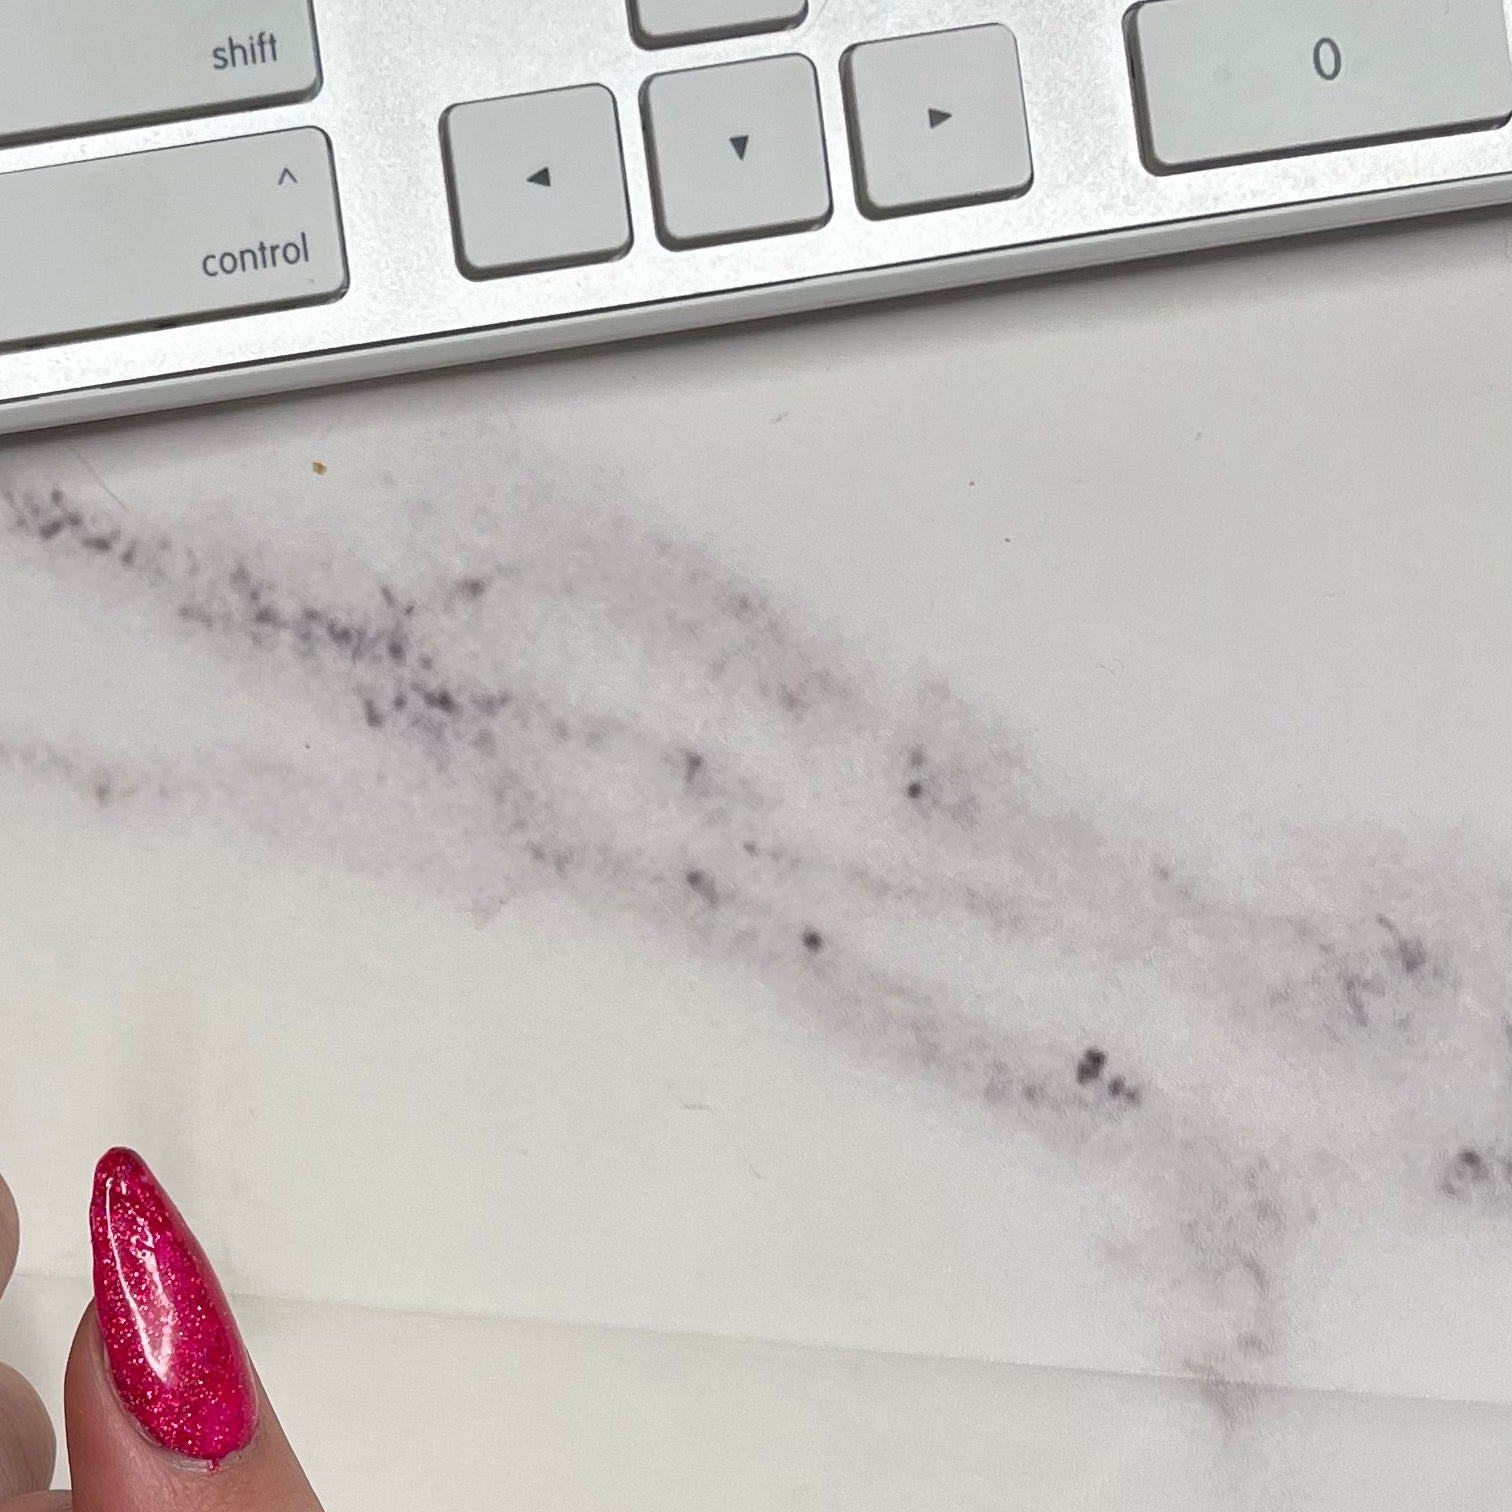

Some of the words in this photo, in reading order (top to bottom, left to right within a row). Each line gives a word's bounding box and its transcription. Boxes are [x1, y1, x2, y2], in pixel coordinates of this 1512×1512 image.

[212, 31, 278, 70] shift
[1312, 37, 1342, 81] 0
[202, 231, 310, 277] control
